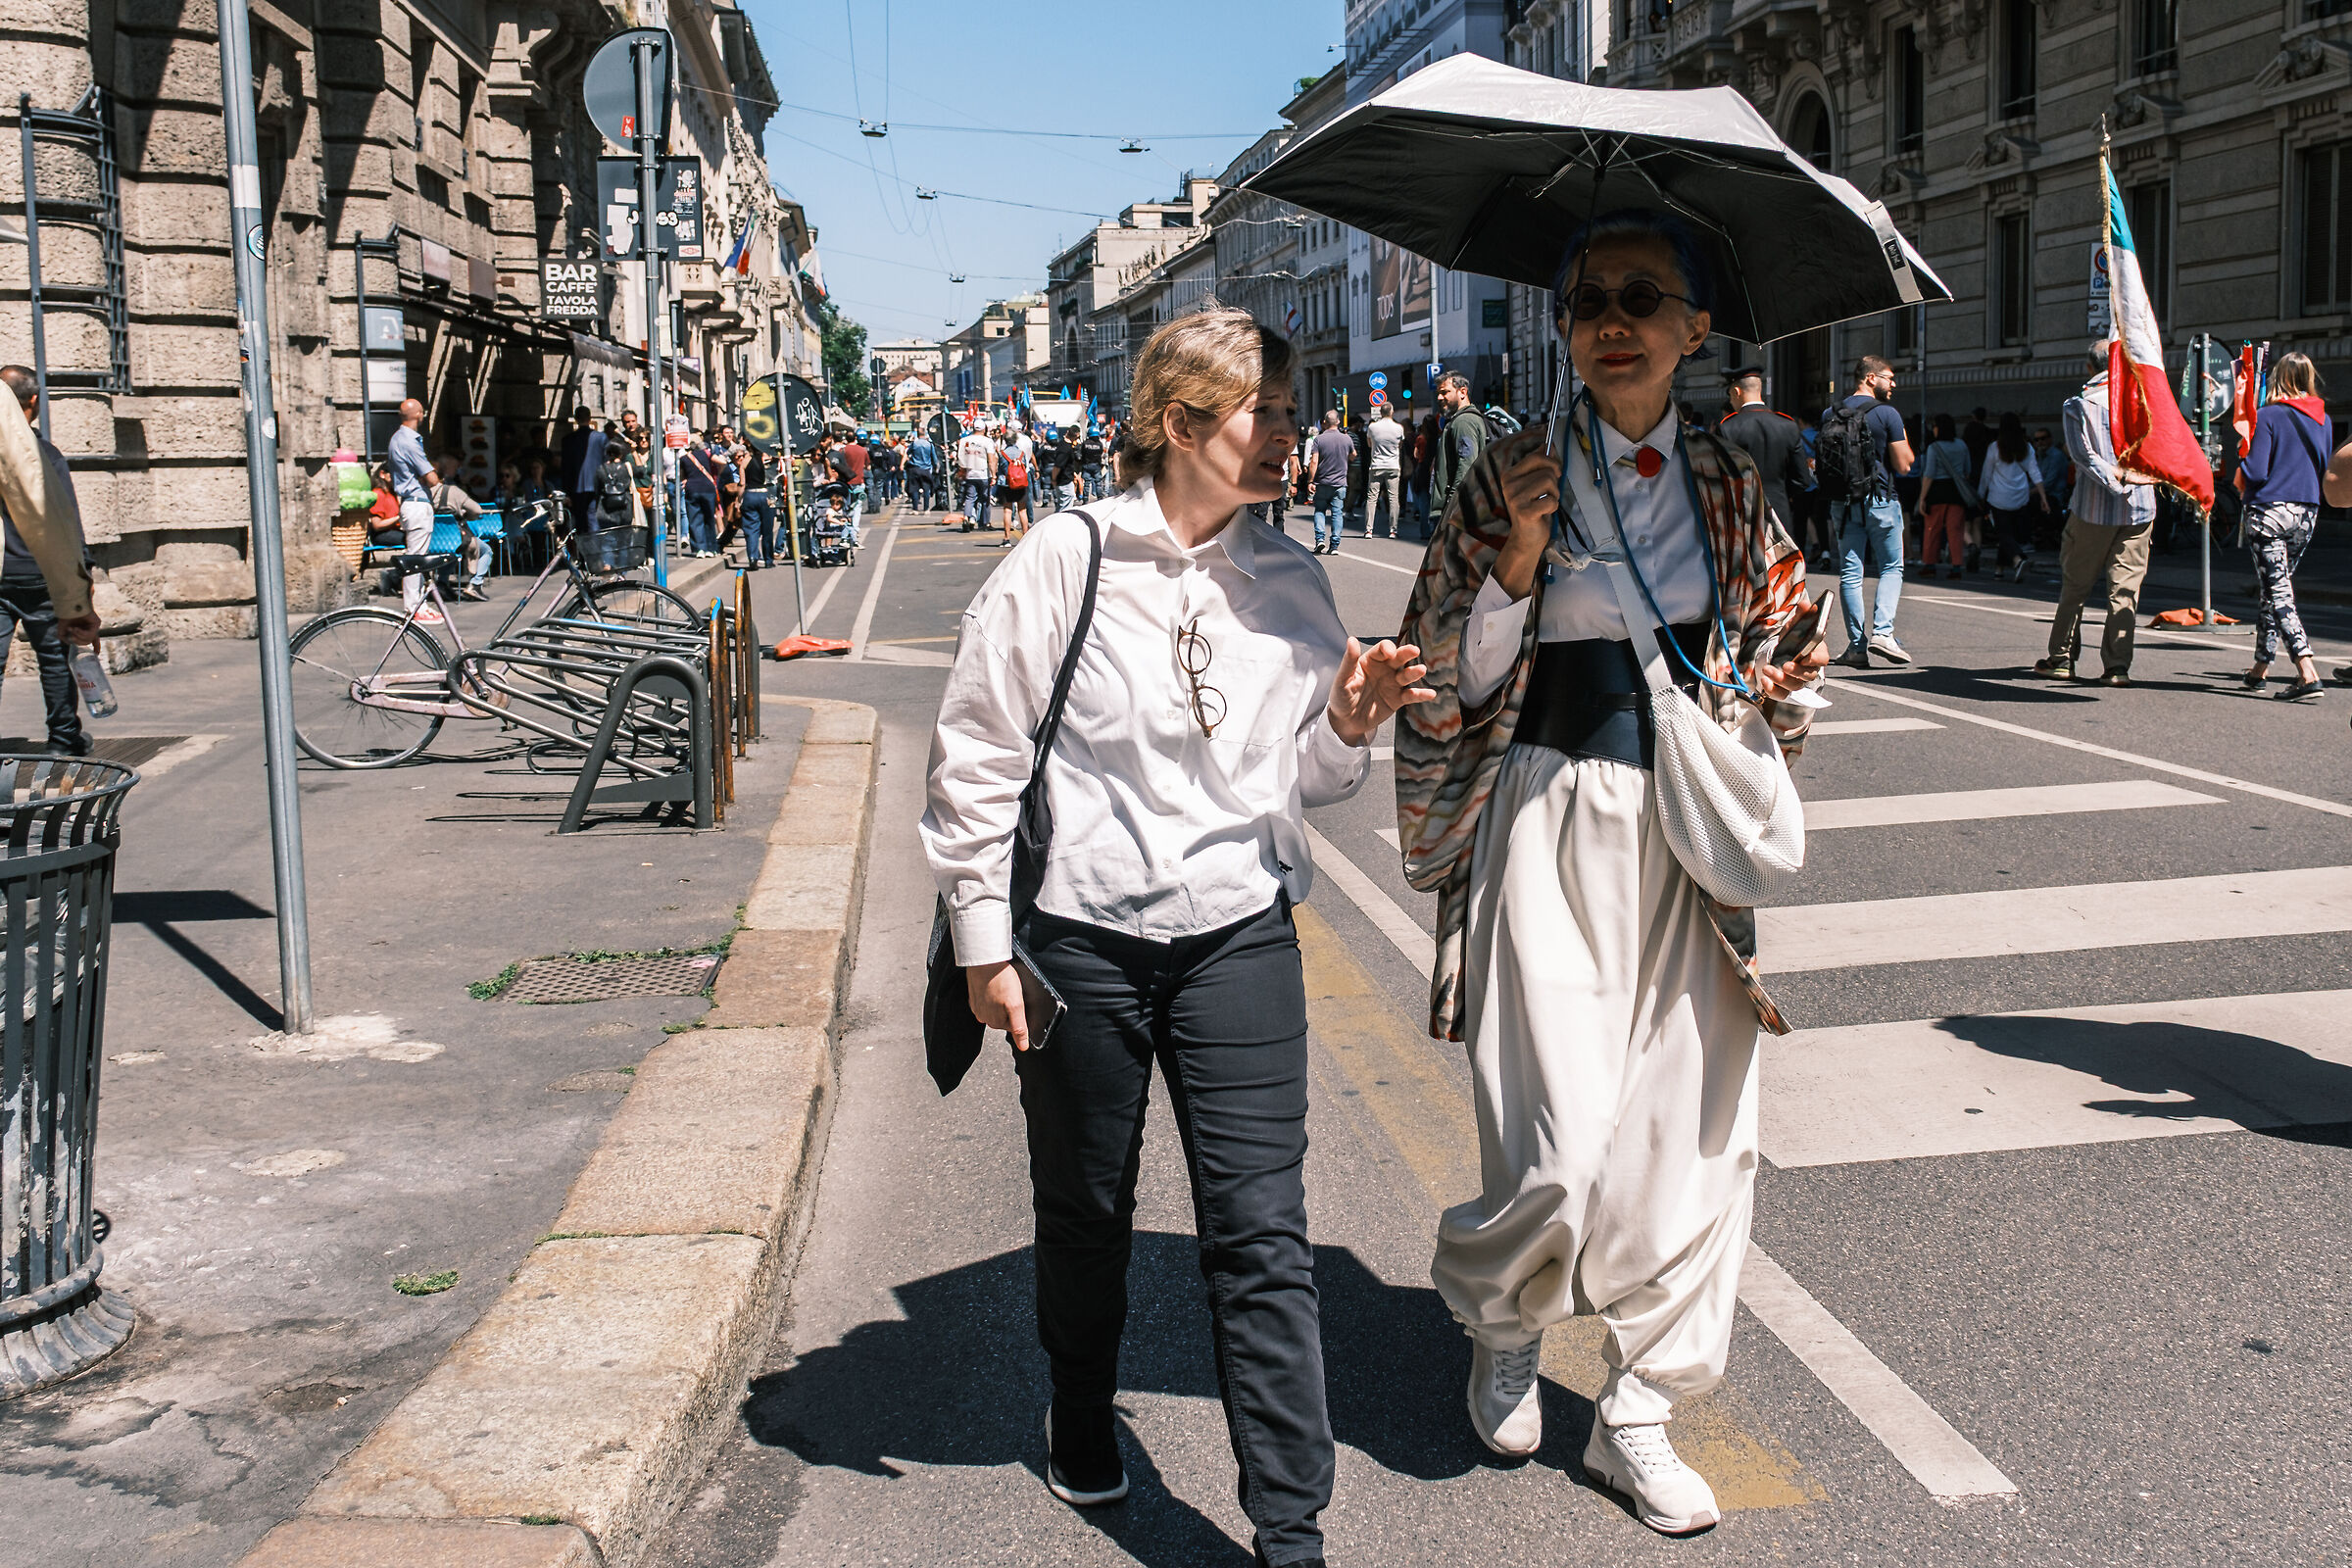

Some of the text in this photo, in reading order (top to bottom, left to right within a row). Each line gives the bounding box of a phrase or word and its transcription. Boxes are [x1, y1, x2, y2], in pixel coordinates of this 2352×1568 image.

[545, 264, 598, 281] BAR
[546, 281, 598, 293] CAFFE'
[546, 295, 598, 306] TAVOLA
[546, 305, 599, 316] FREDDA
